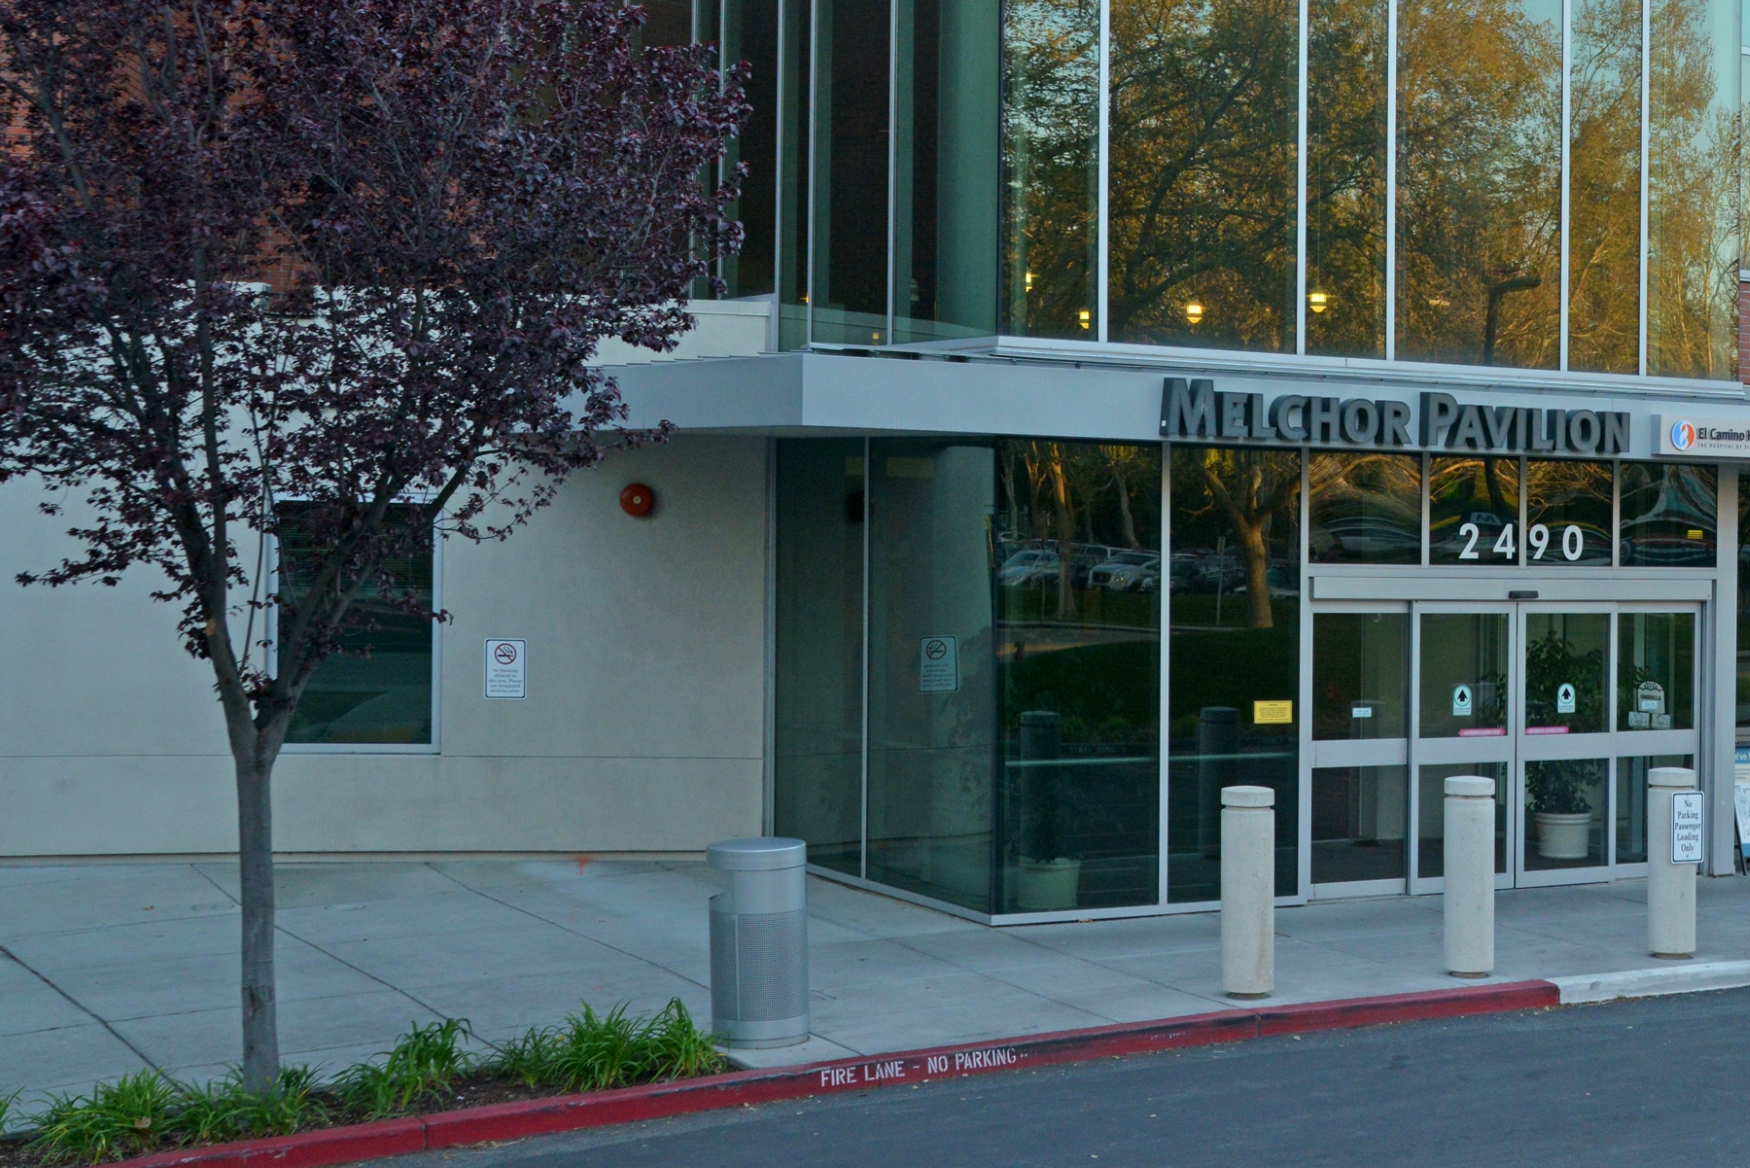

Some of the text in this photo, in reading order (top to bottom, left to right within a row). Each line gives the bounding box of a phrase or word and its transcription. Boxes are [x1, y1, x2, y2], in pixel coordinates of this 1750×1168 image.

[1160, 377, 1631, 453] MELCHOR PAVILION
[1698, 428, 1708, 440] El
[1710, 428, 1745, 441] Camino
[1458, 522, 1584, 561] 2490
[1735, 752, 1748, 761] e've
[1684, 799, 1692, 808] No
[1677, 811, 1699, 821] Parking
[1675, 822, 1701, 832] Passenger
[1677, 832, 1699, 843] Loading
[1681, 843, 1694, 854] Only
[820, 1067, 857, 1087] FIRE
[864, 1060, 906, 1082] LANE
[927, 1055, 950, 1074] NO
[955, 1046, 1017, 1071] PARKING
